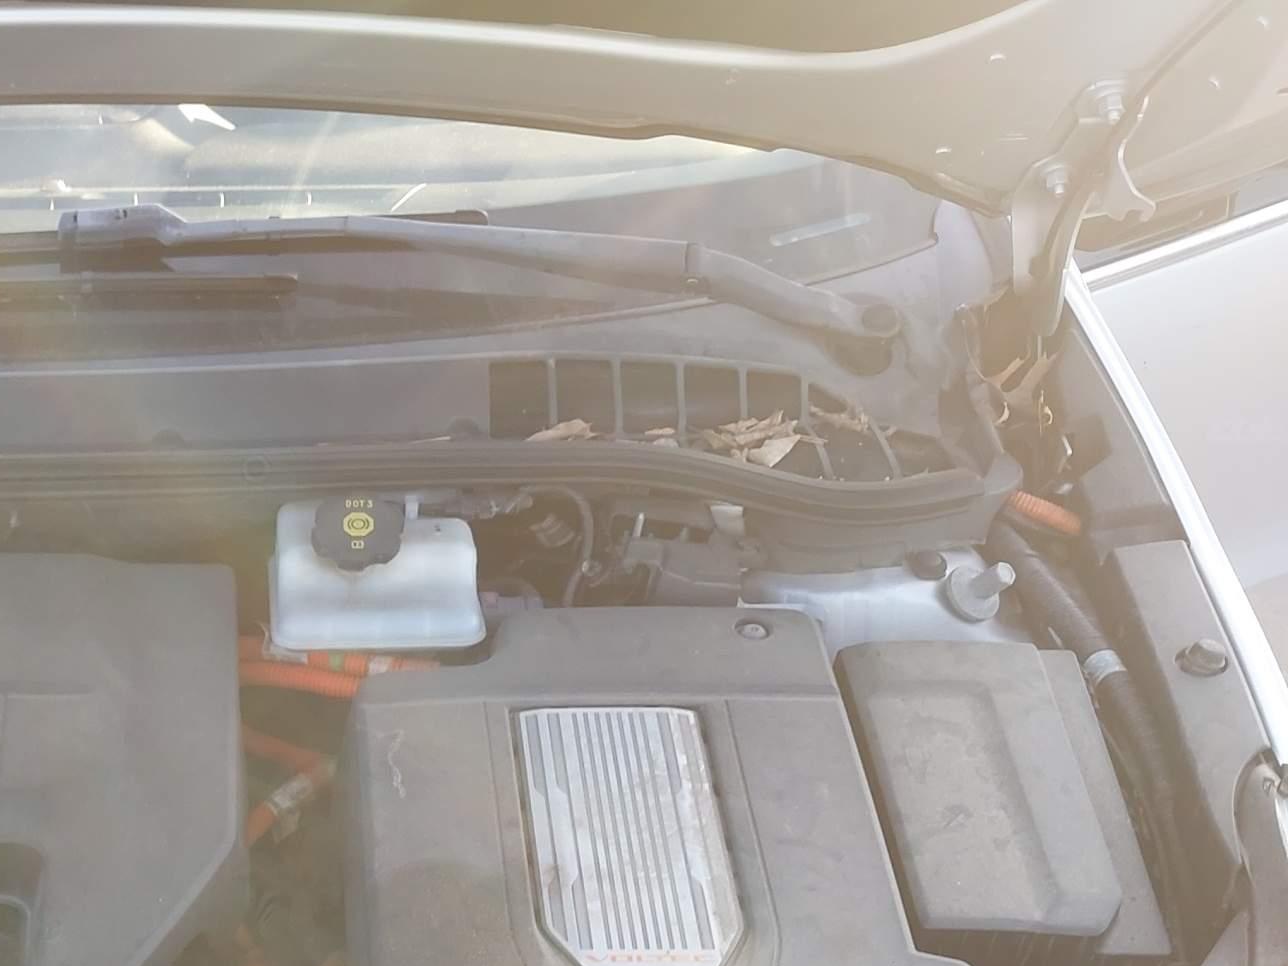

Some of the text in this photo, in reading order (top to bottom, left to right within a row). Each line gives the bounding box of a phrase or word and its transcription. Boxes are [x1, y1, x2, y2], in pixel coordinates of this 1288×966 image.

[345, 499, 373, 508] DOT 3
[585, 952, 713, 962] VOLTEC
